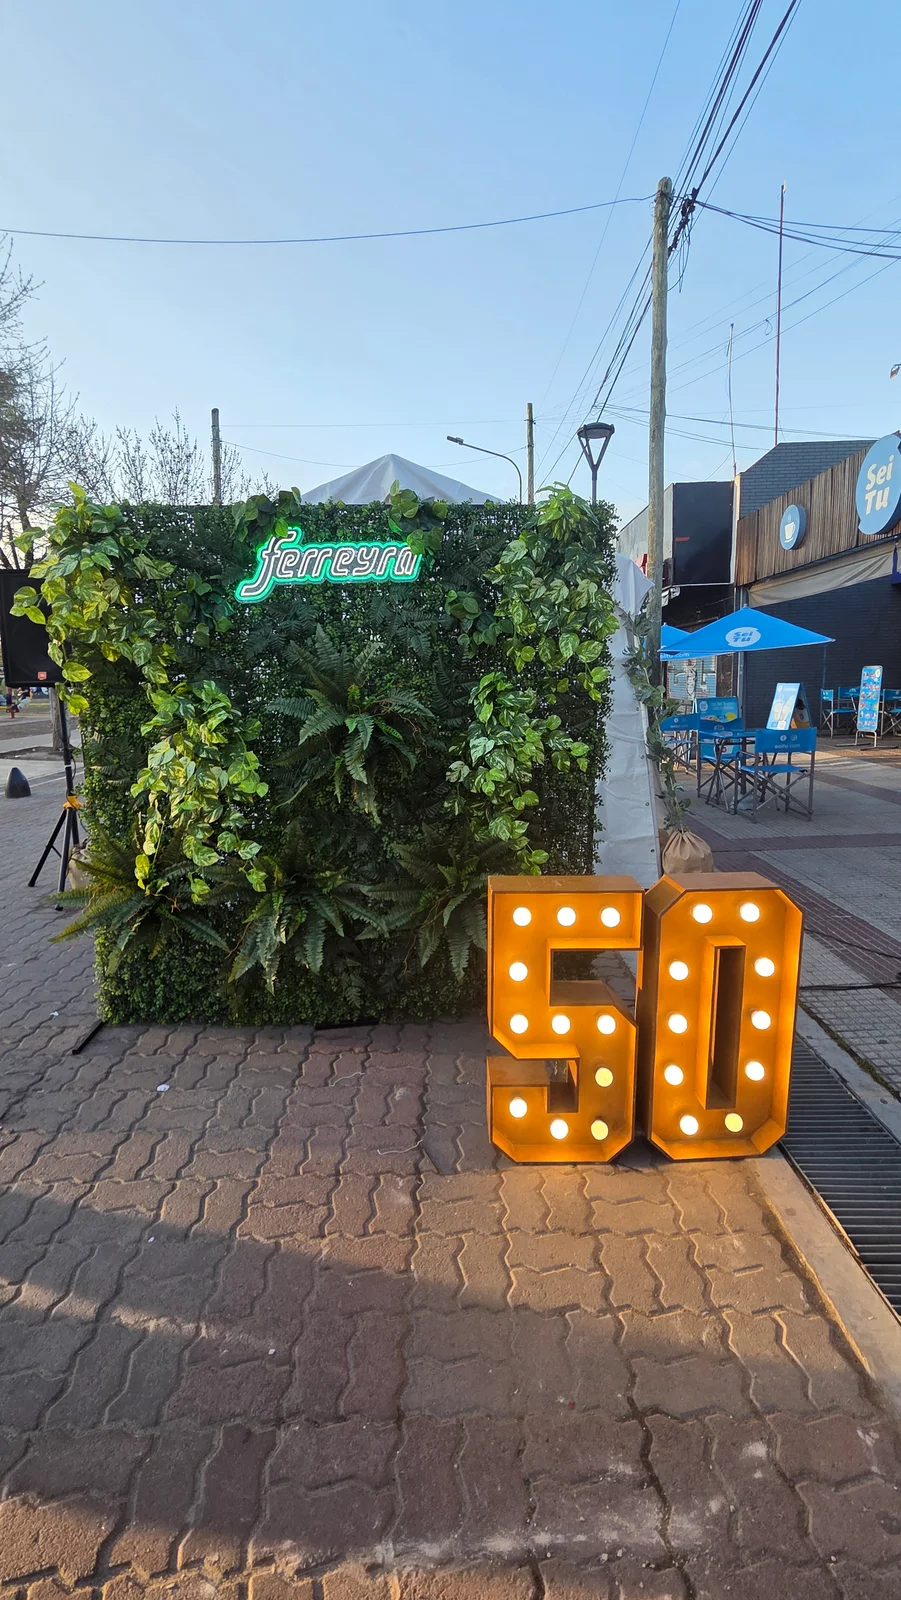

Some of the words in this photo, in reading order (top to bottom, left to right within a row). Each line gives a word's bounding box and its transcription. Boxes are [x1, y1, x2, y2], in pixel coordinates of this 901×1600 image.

[865, 455, 894, 491] Sei
[865, 487, 890, 515] Tu
[238, 529, 416, 597] ferreyra
[488, 873, 803, 1163] 50
